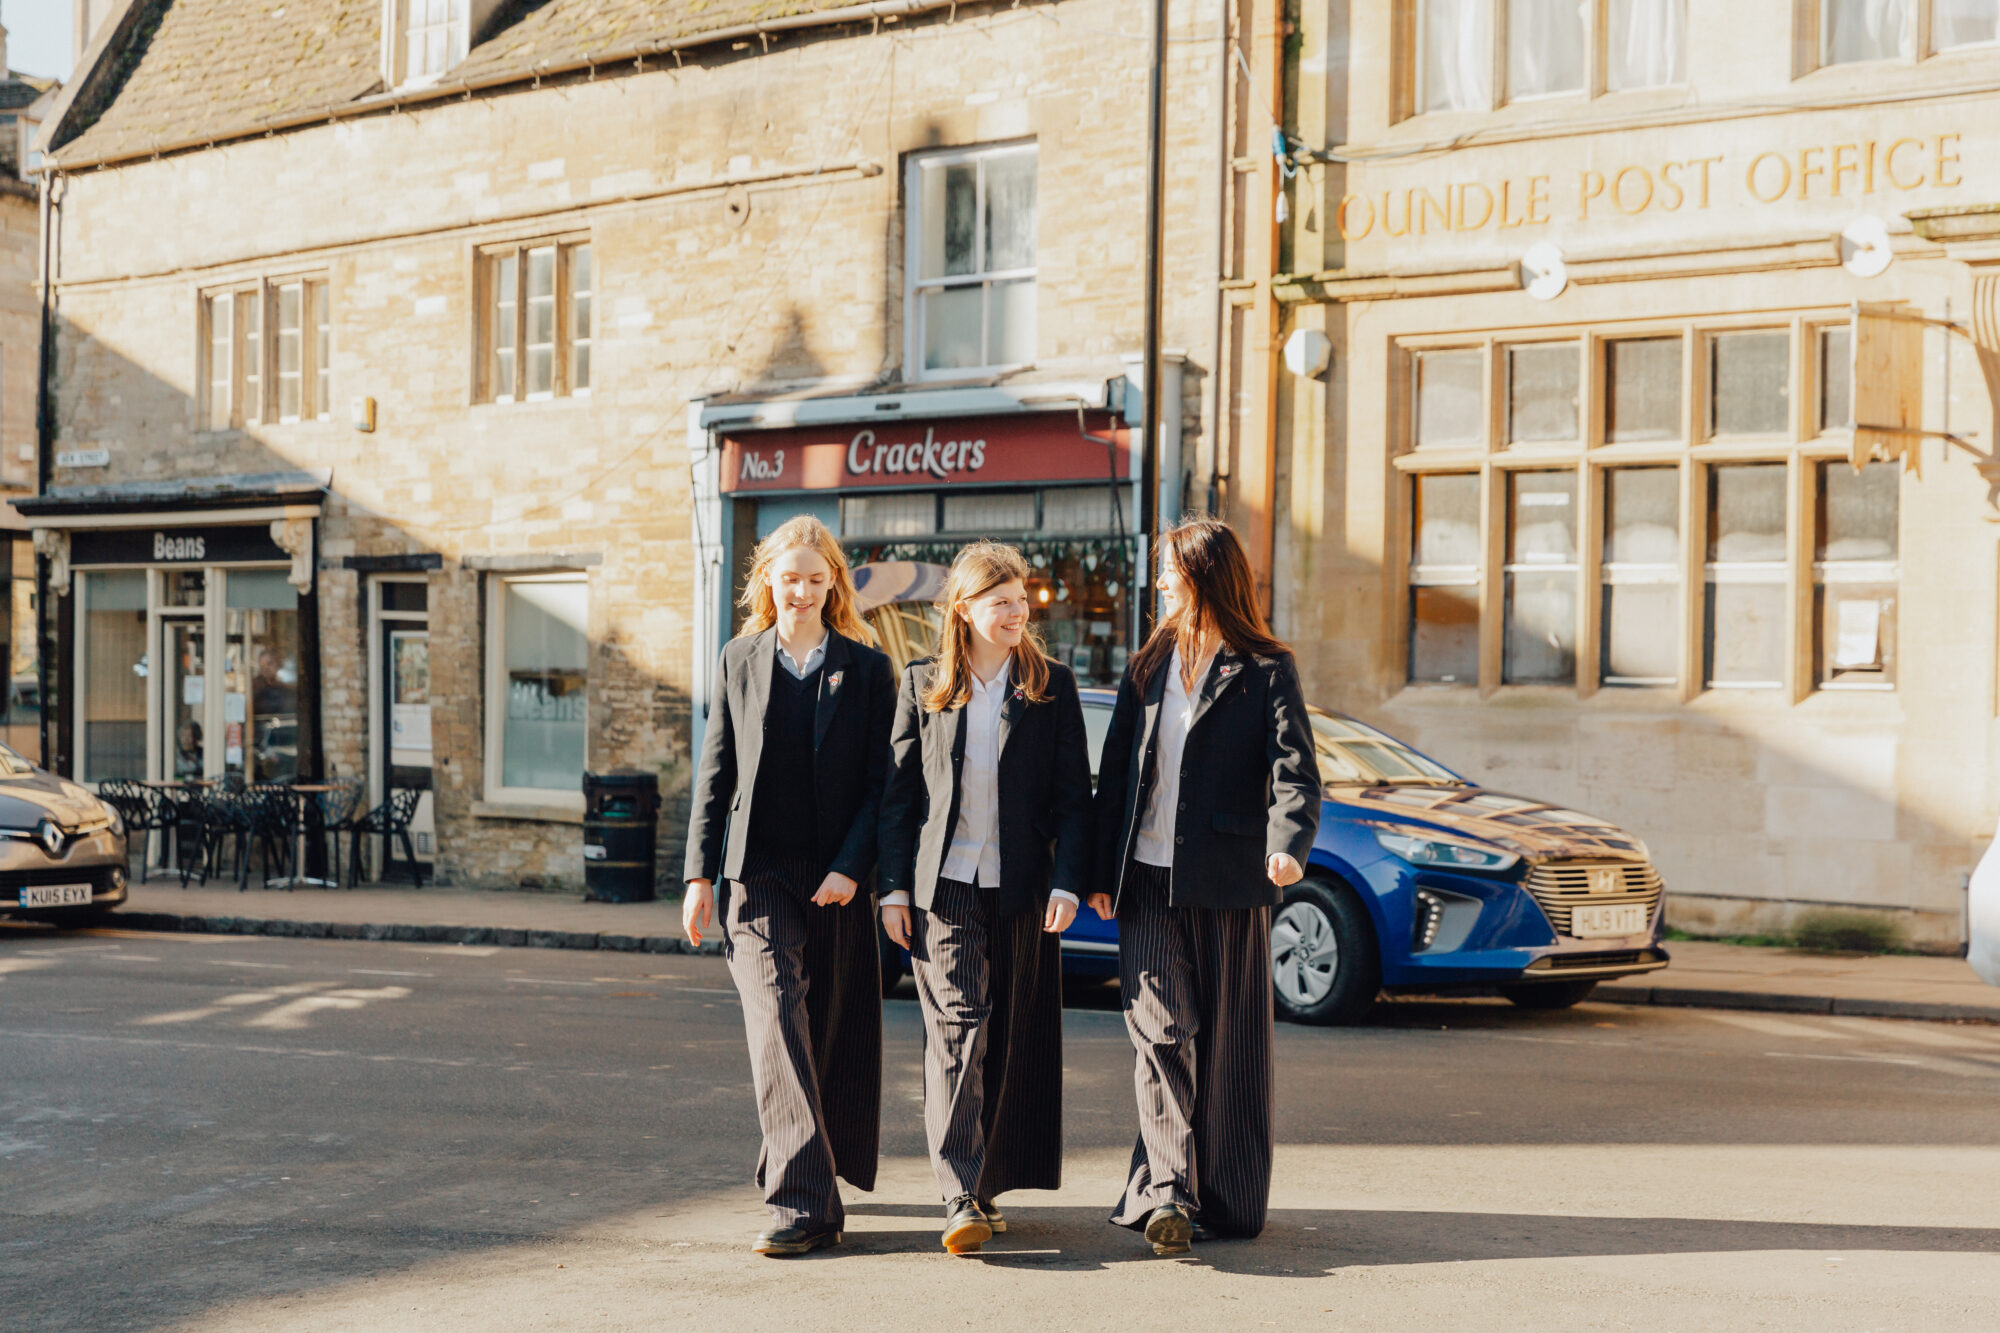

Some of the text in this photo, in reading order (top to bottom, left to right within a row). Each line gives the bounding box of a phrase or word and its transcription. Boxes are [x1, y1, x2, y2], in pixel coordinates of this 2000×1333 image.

[1336, 132, 1963, 242] OUNDLE POST OFFICE
[740, 426, 987, 481] No.3 Crackers
[153, 531, 206, 560] Beans
